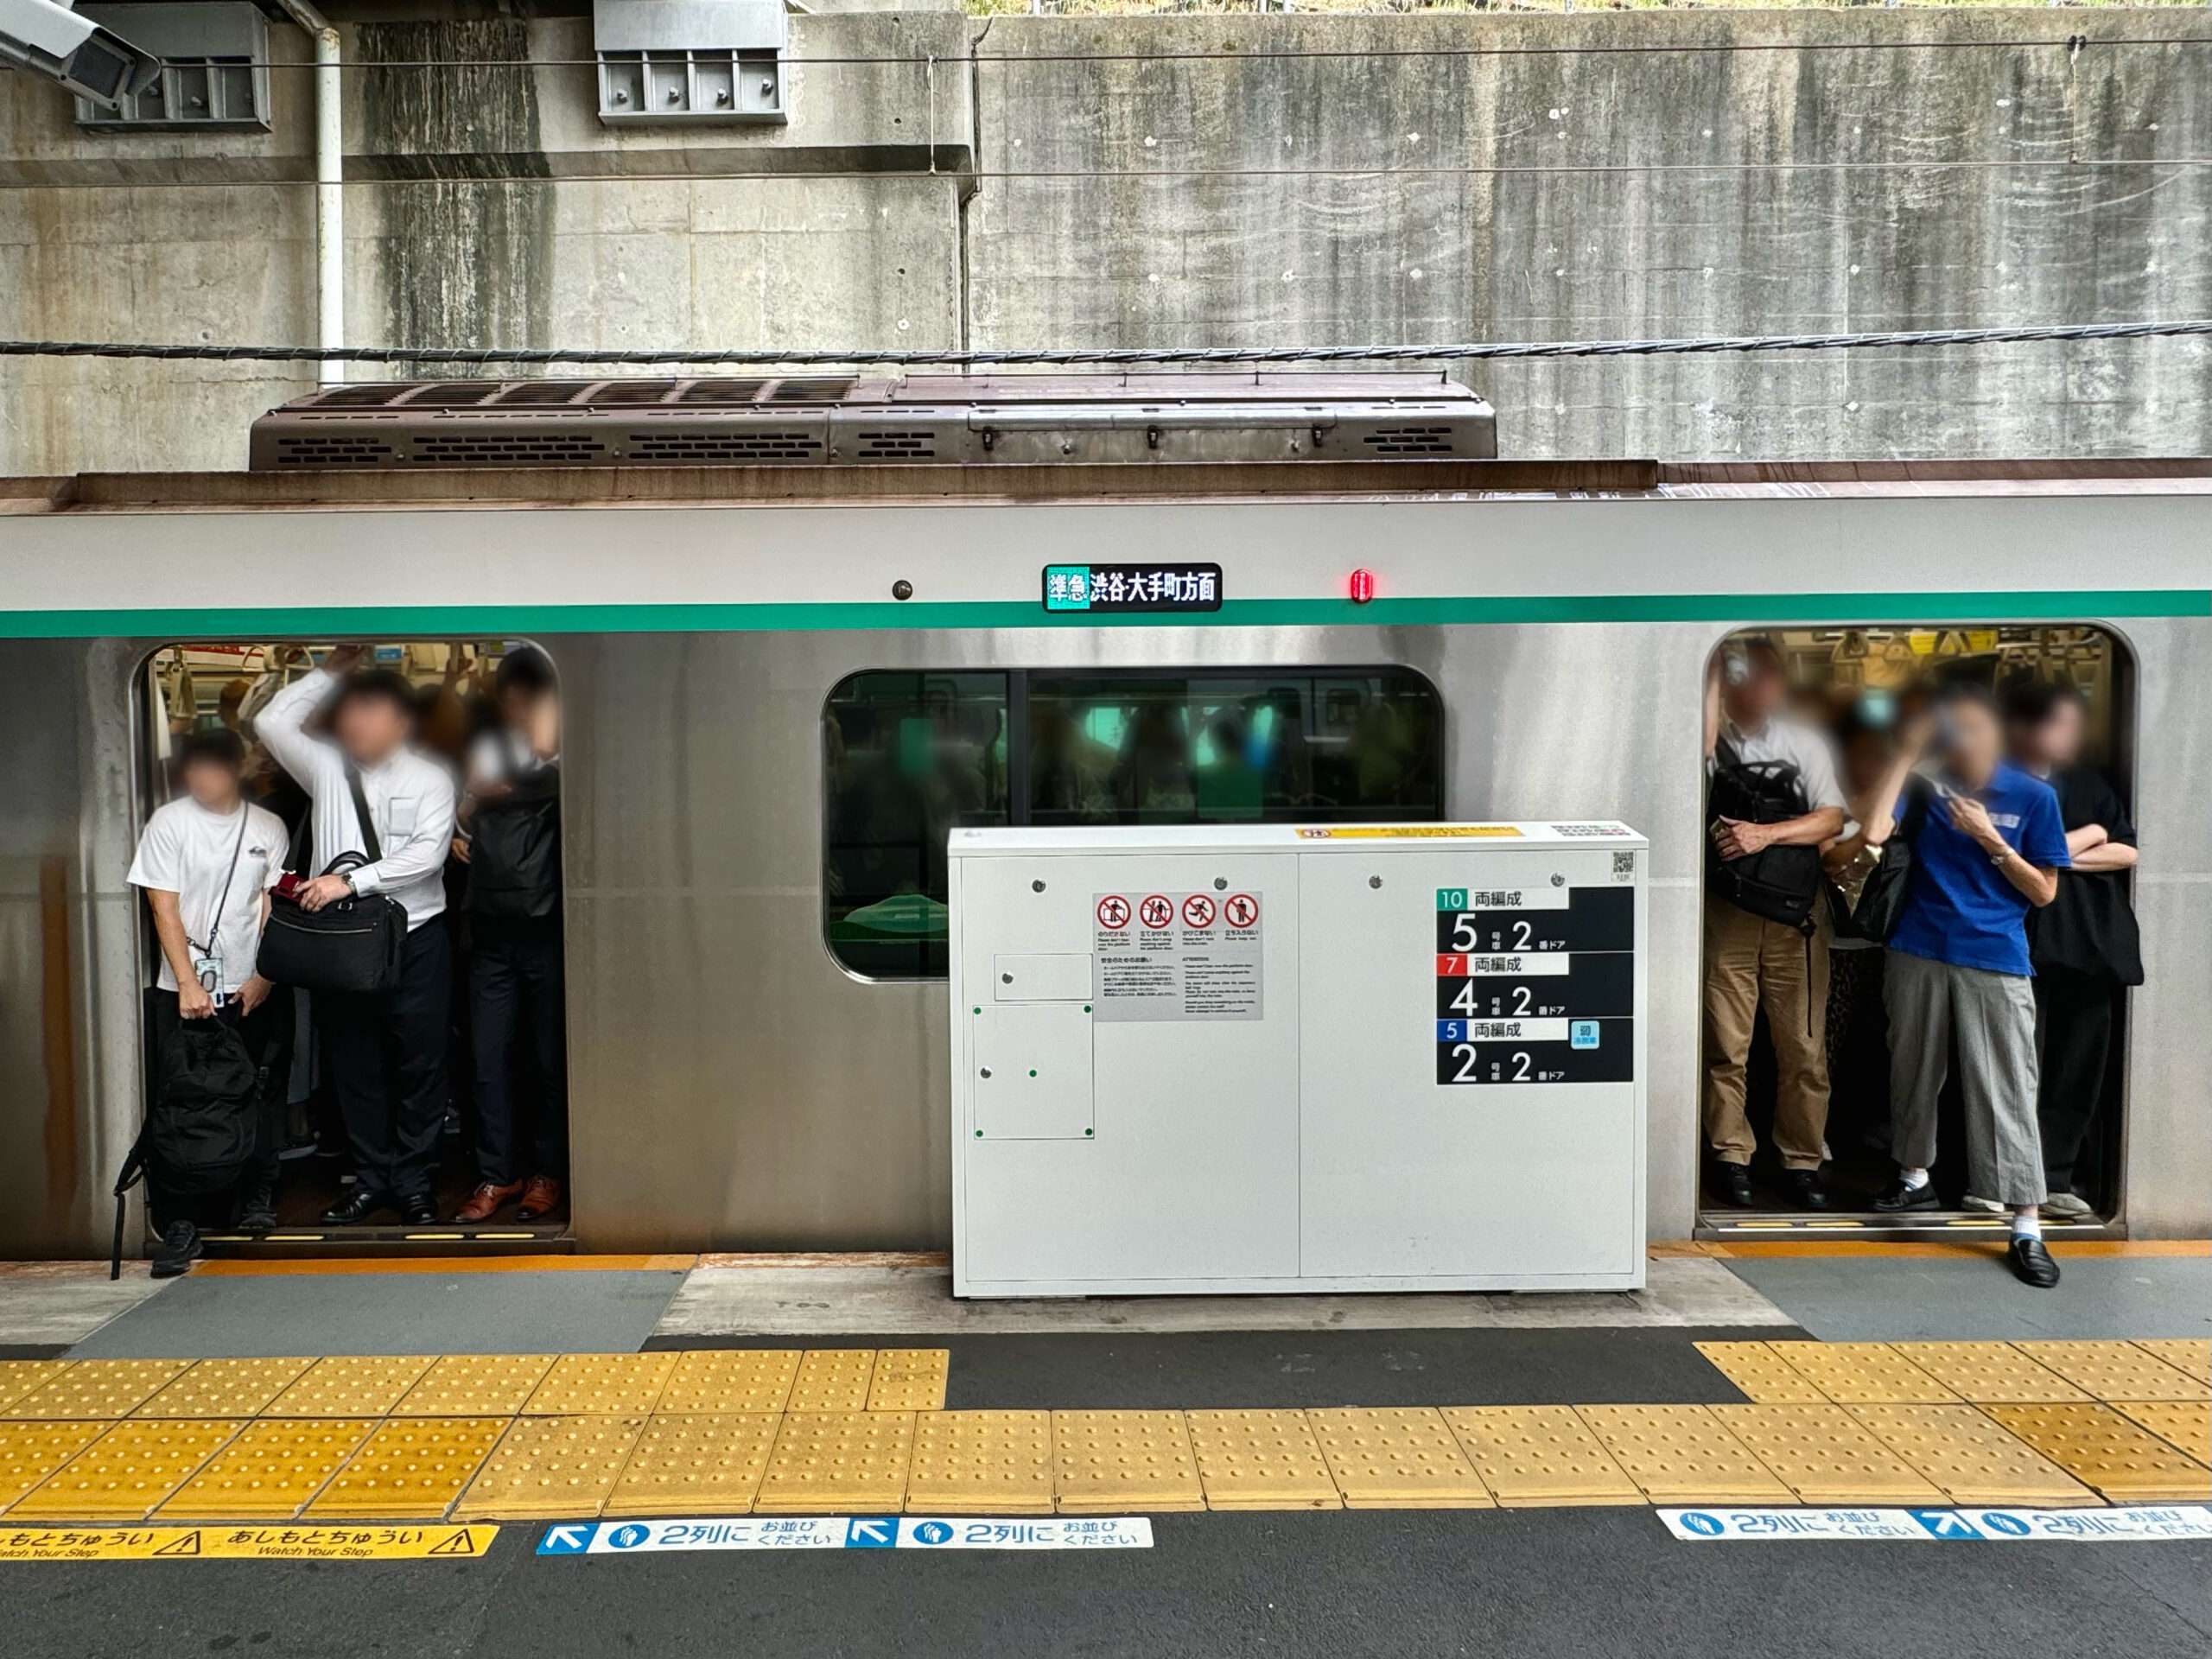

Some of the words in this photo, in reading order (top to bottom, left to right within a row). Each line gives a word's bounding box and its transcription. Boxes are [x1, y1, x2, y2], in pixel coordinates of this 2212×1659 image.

[1049, 573, 1087, 602] 準急
[1441, 891, 1463, 907] 10
[1474, 891, 1522, 907] 両編成
[1451, 912, 1478, 952] 5
[1512, 921, 1532, 950] 2
[1538, 939, 1567, 950] 番ドア
[1446, 957, 1459, 974] 7
[1474, 957, 1522, 973] 両編成
[1449, 977, 1478, 1017] 4
[1512, 987, 1532, 1016] 2
[1446, 1022, 1458, 1039] 5
[1474, 1022, 1522, 1039] 両編成
[1451, 1043, 1478, 1083] 2
[1512, 1052, 1532, 1082] 2
[1731, 1512, 1830, 1533] 2列に
[1826, 1511, 1881, 1523] お並び
[2124, 1510, 2183, 1522] お並び
[760, 1521, 819, 1533] お並び
[1063, 1522, 1119, 1533] お並び
[1839, 1524, 1916, 1536] ください
[2033, 1514, 2134, 1535] 2列に
[0, 1532, 154, 1547] もとちゅうい
[227, 1529, 423, 1544] あしもとちゅうい
[658, 1524, 752, 1545] 2列に
[757, 1534, 832, 1546] ください
[965, 1524, 1054, 1544] 2列に
[1064, 1534, 1139, 1546] ください
[258, 1547, 302, 1556] Watch
[307, 1547, 340, 1555] Your
[340, 1547, 374, 1558] Step
